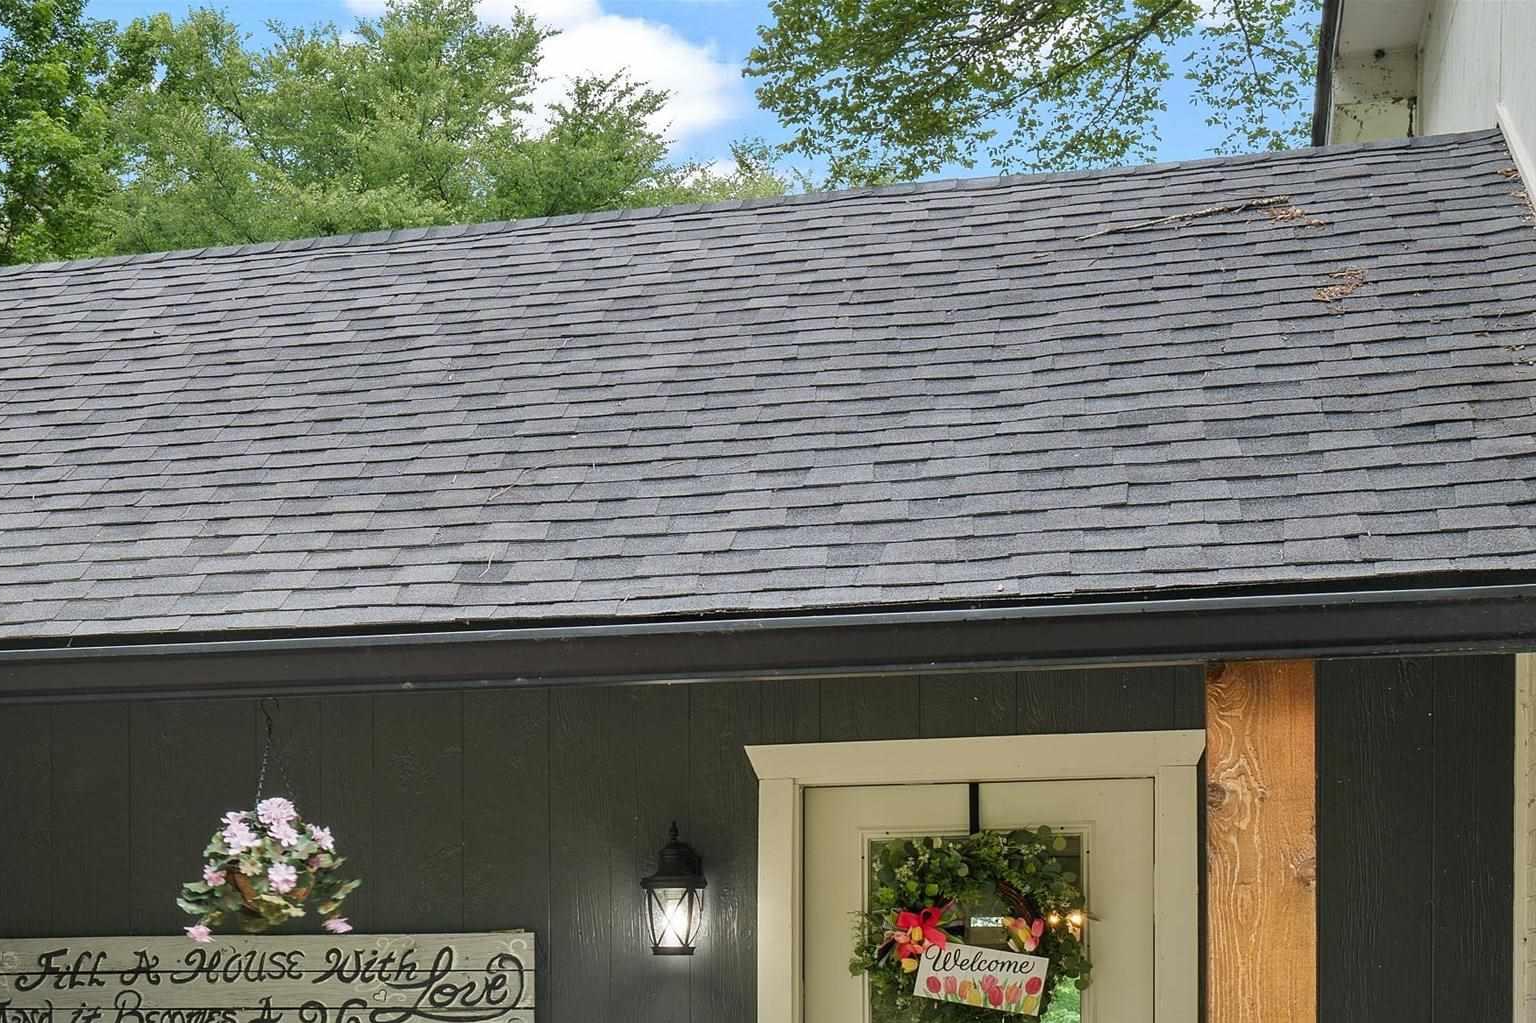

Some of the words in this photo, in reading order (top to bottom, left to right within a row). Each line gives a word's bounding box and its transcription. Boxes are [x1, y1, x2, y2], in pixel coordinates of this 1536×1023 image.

[120, 950, 161, 985] A
[312, 948, 418, 984] With
[369, 946, 524, 1022] Love
[925, 944, 1035, 975] Welcome
